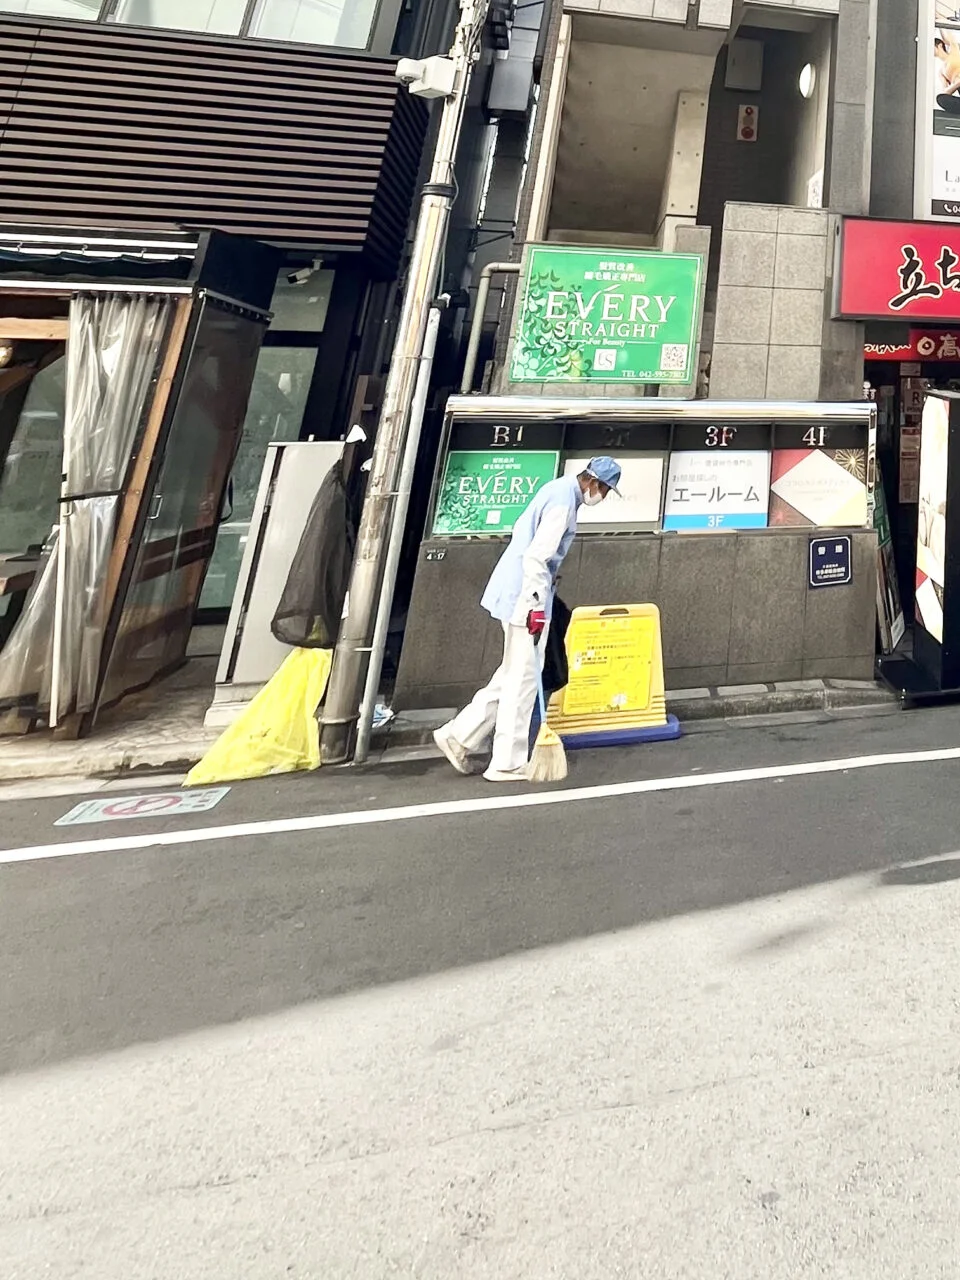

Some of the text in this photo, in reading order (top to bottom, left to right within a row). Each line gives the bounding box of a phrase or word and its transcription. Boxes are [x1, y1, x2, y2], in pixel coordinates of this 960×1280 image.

[945, 169, 960, 183] La
[554, 321, 660, 338] STRAIGHT
[622, 370, 636, 378] TEL
[490, 425, 524, 447] B1
[705, 425, 738, 447] 3F
[463, 494, 529, 504] STRAIGHT
[672, 486, 760, 503] エールーム
[707, 515, 725, 528] 3F
